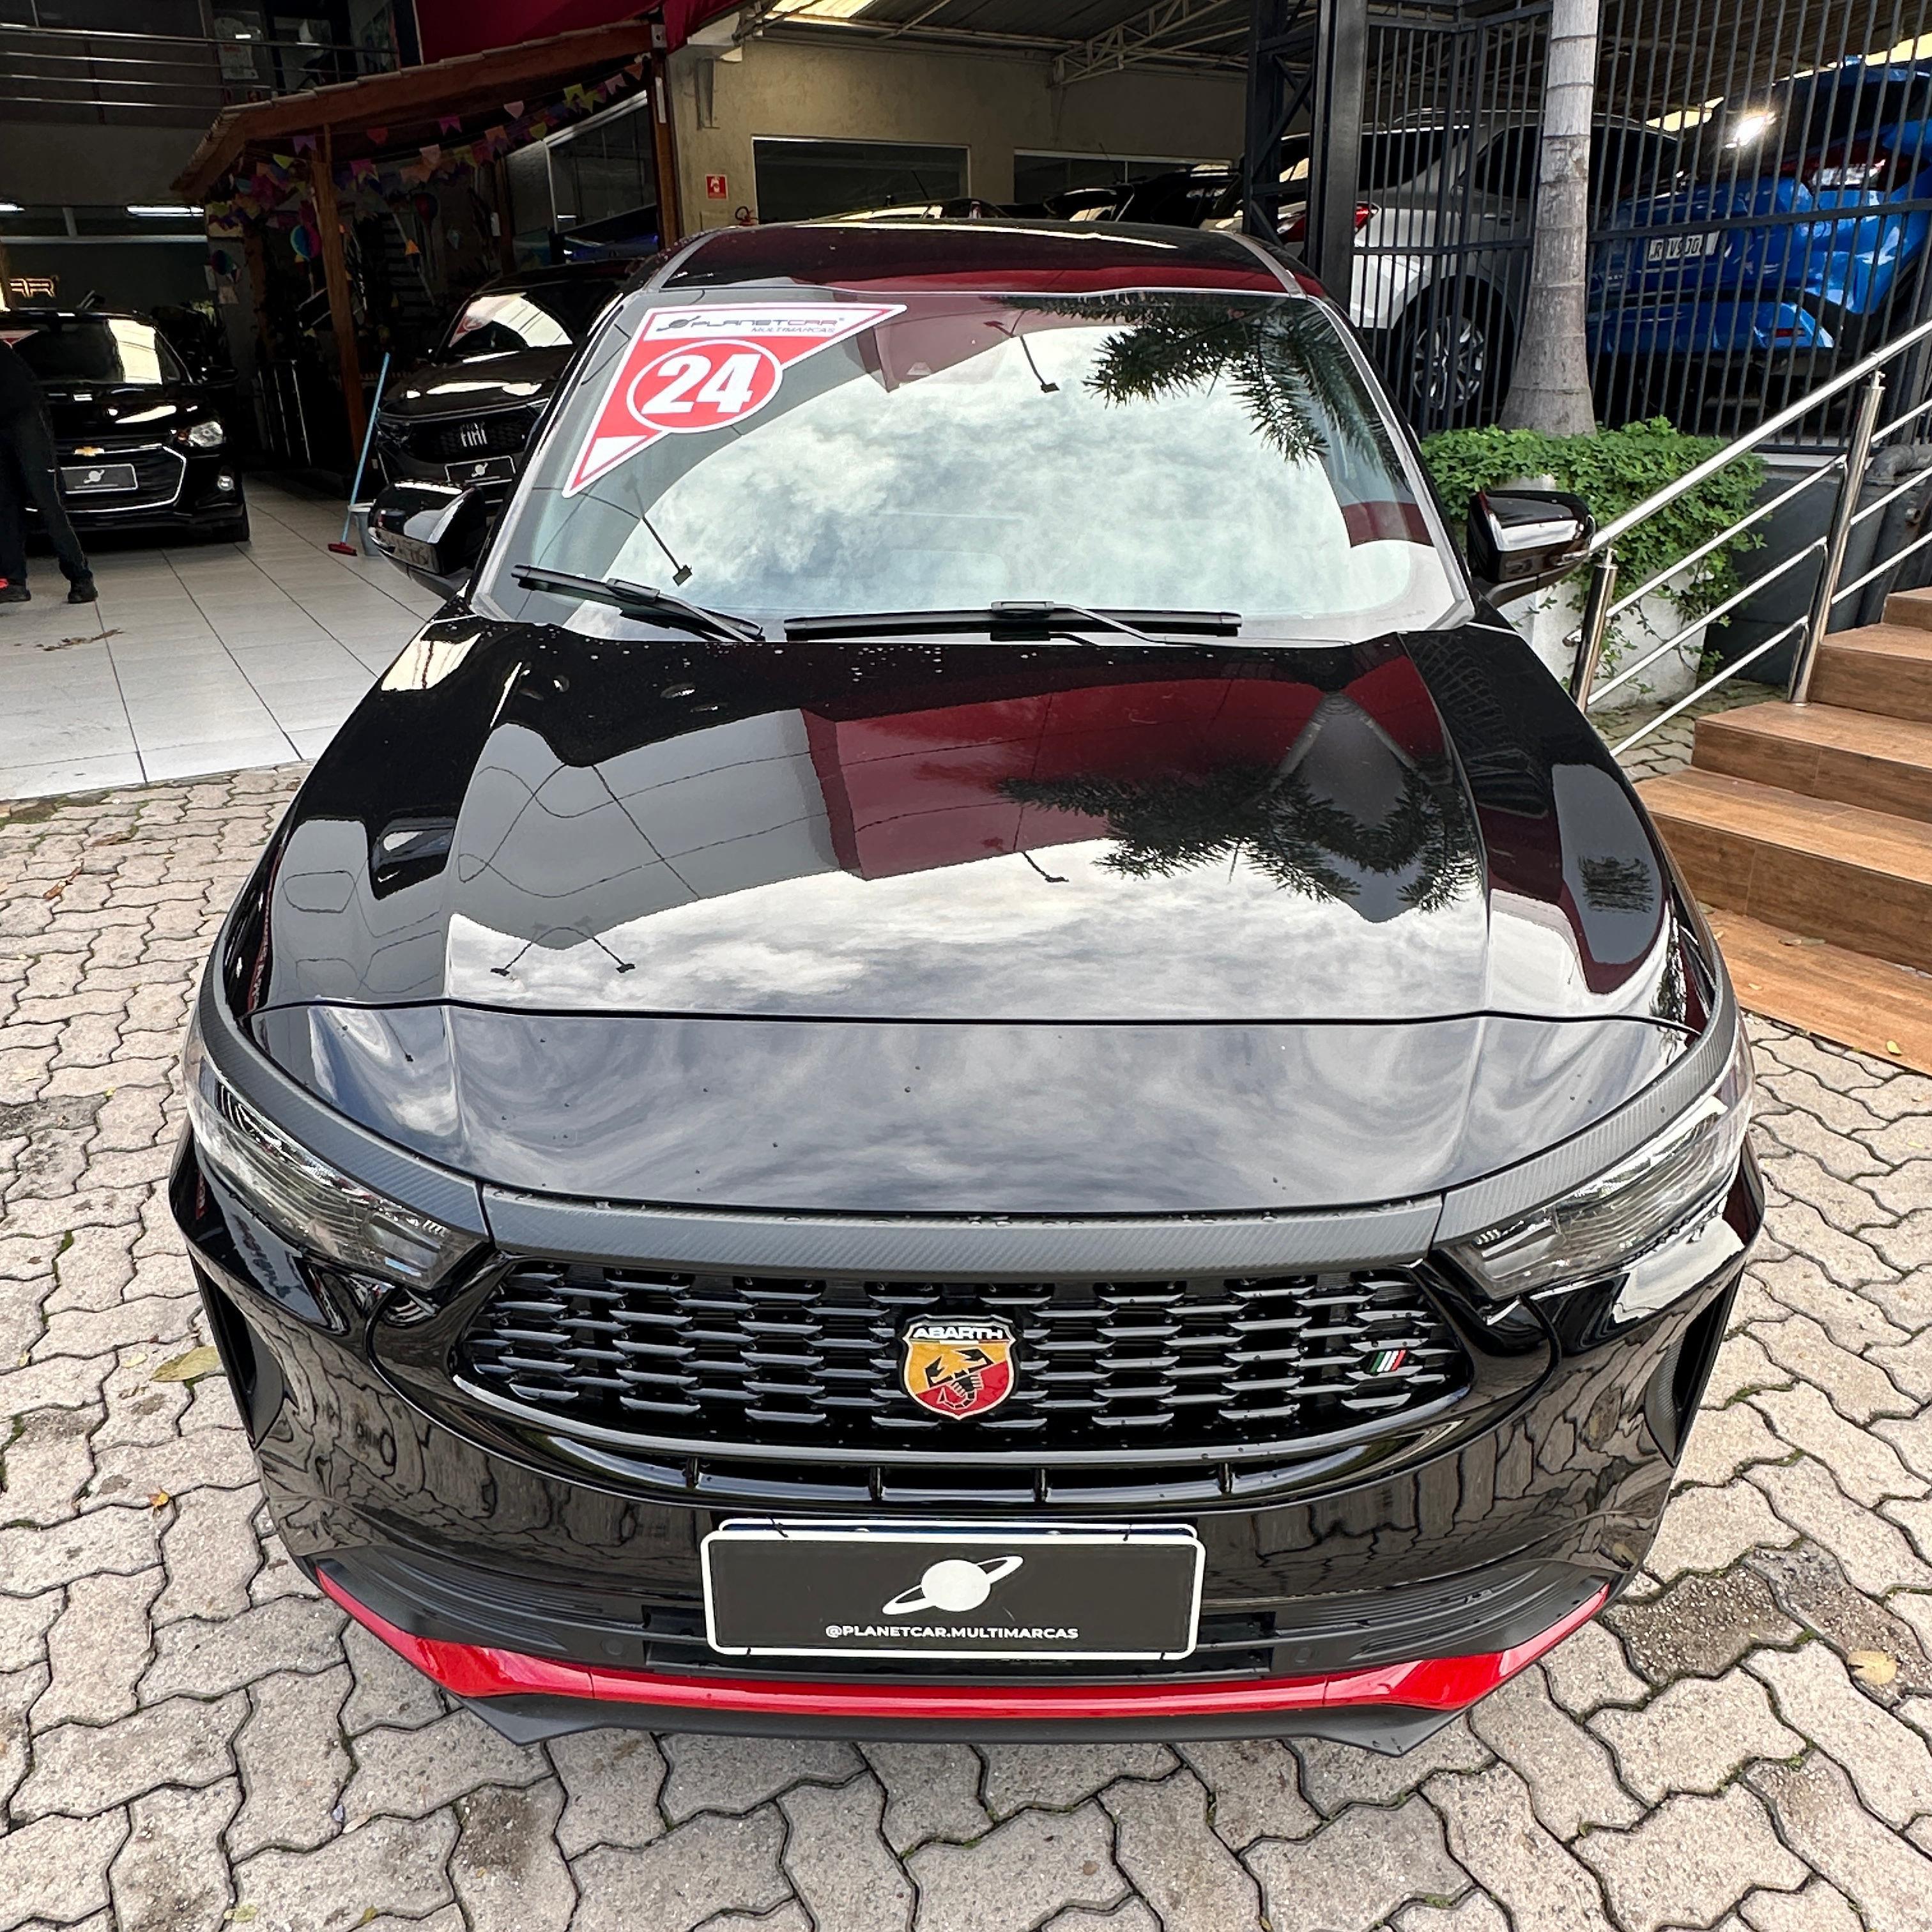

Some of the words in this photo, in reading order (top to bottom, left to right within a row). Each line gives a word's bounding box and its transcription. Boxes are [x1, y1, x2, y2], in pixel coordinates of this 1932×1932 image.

[640, 353, 762, 415] 24
[460, 421, 488, 447] FIAT
[912, 1326, 1004, 1340] ABARTH
[825, 1625, 1080, 1640] @PLANETCAR.MULTIMARCAS
